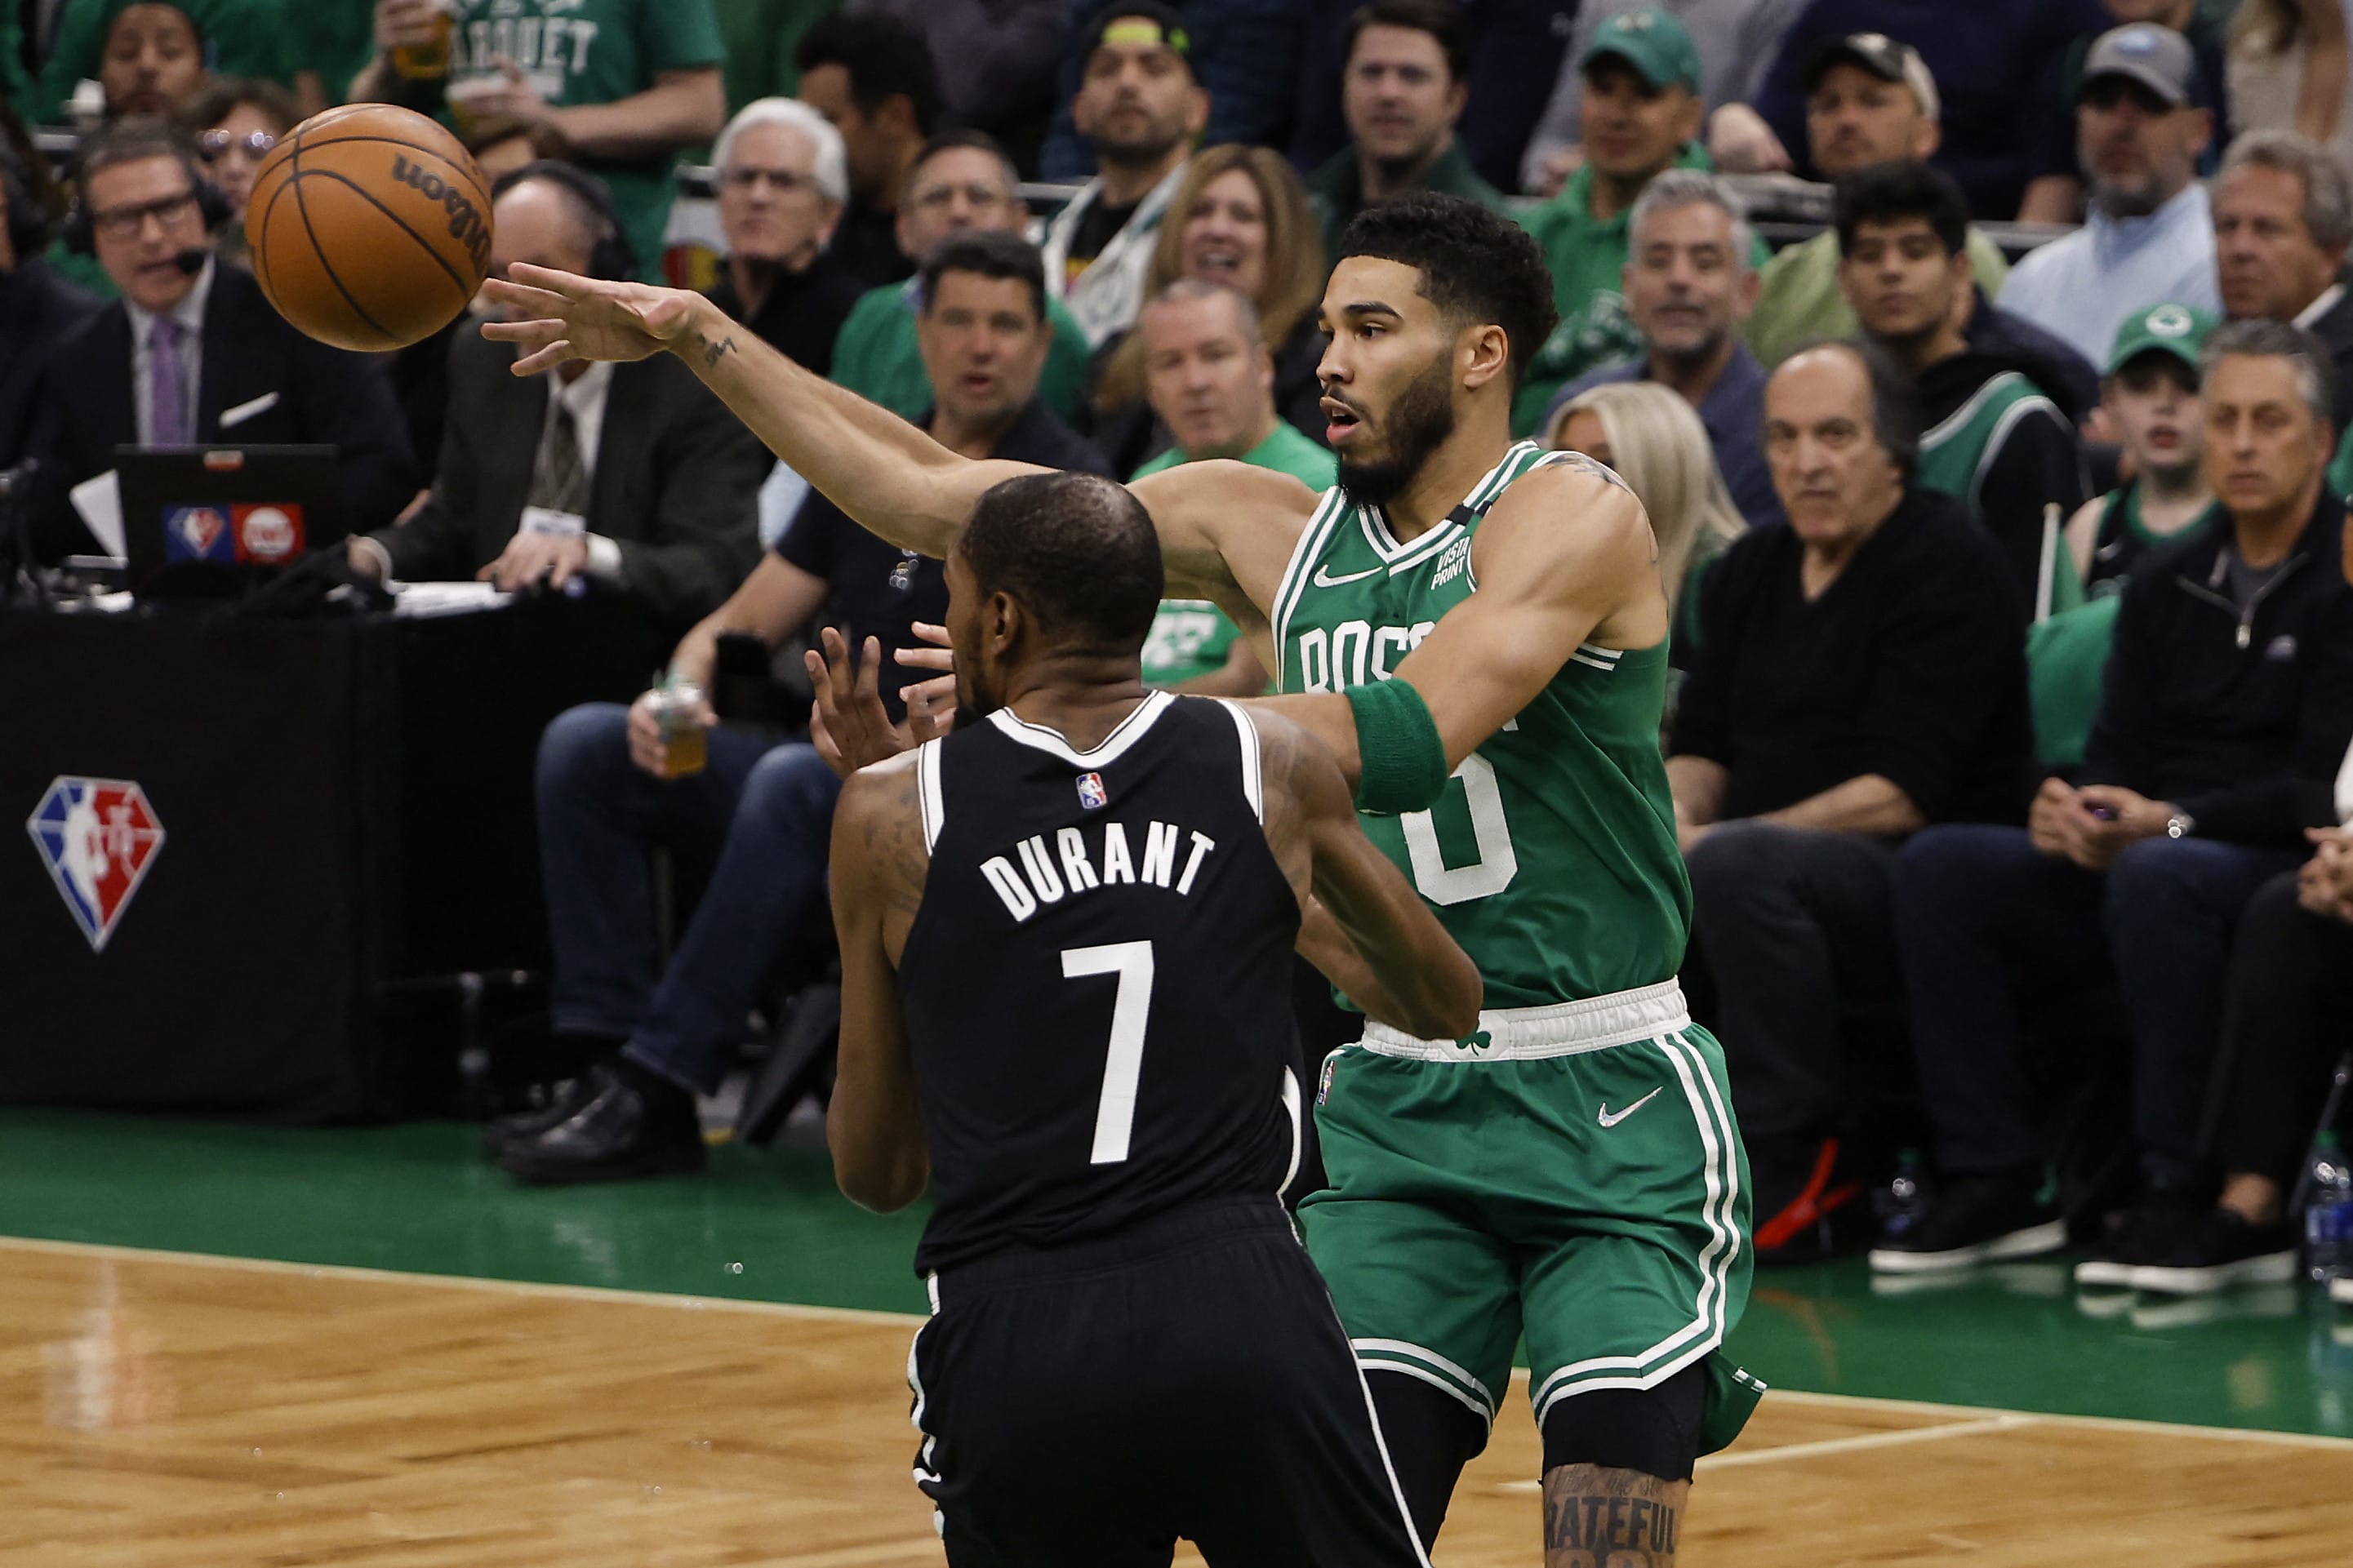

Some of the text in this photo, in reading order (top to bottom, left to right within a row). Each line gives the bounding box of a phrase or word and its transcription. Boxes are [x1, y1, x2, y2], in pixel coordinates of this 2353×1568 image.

[1431, 556, 1466, 590] PRINT
[1437, 536, 1470, 572] VISTA
[1300, 620, 1436, 694] BOS
[980, 820, 1215, 922] DURANT
[1061, 940, 1154, 1164] 7
